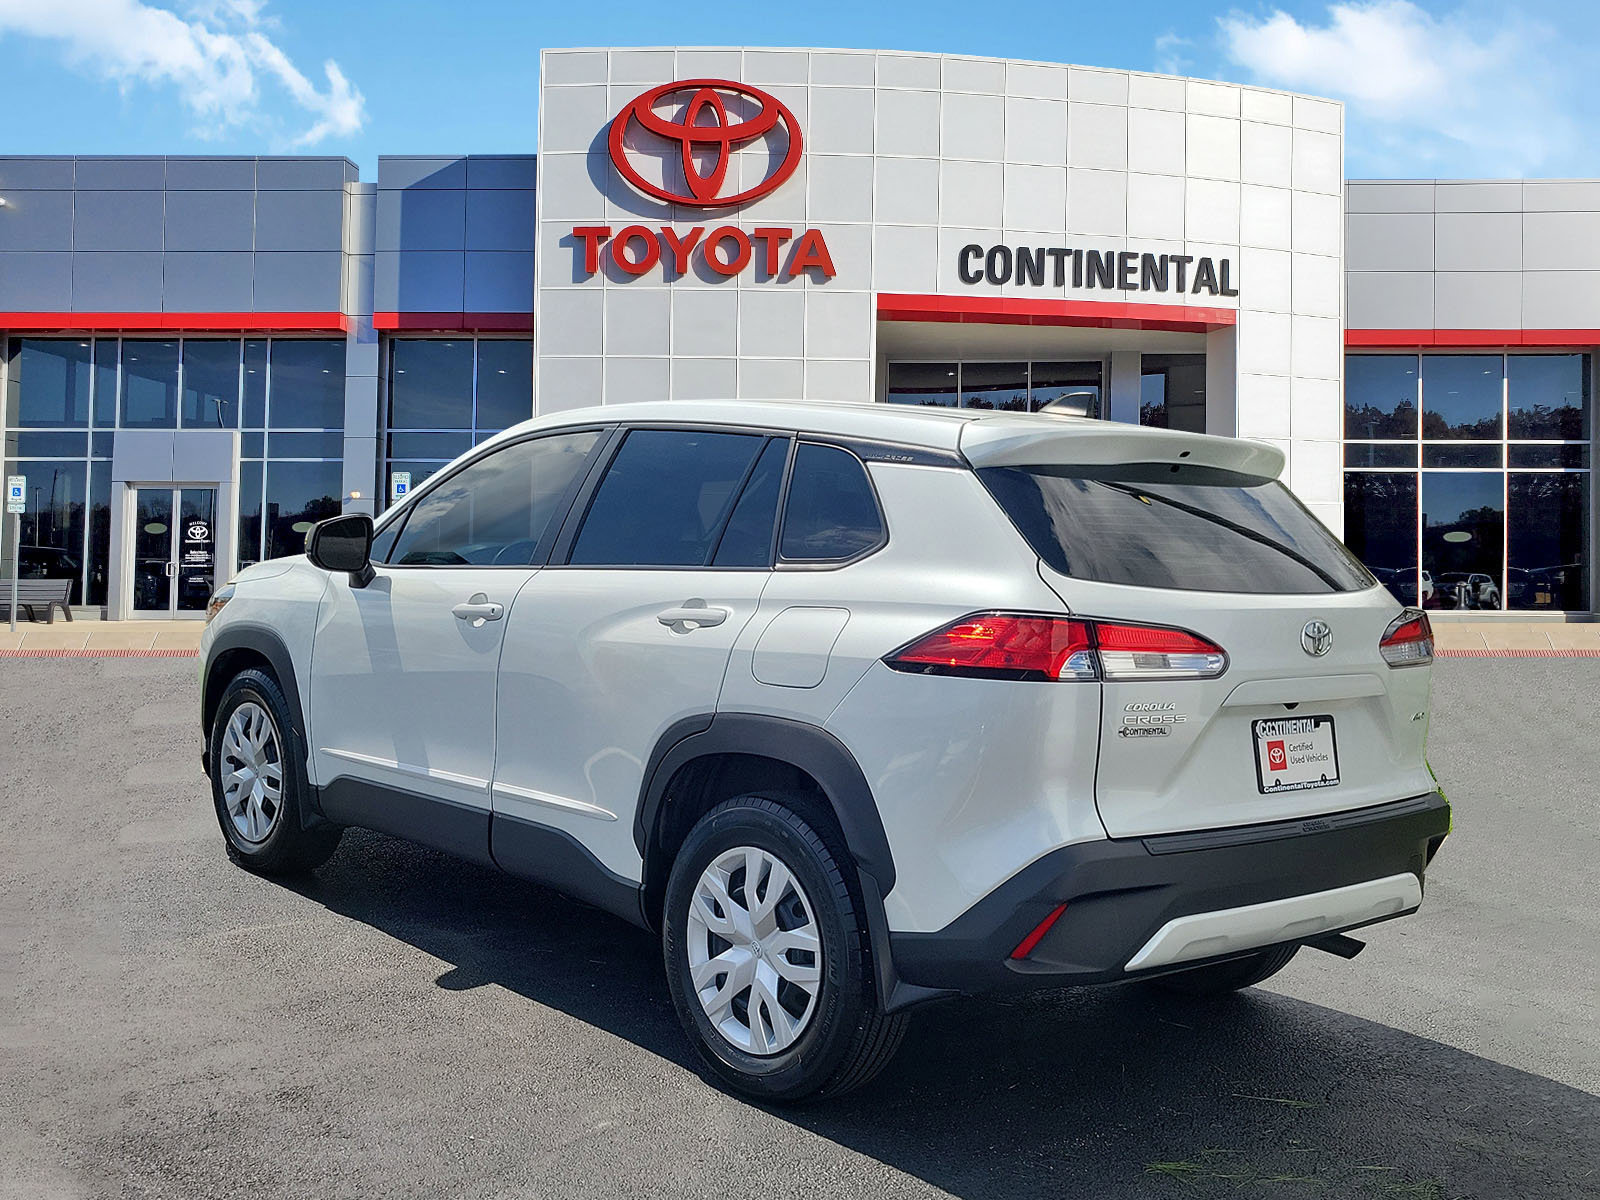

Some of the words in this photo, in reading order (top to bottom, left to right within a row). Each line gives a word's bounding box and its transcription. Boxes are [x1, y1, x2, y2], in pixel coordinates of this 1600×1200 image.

[572, 225, 836, 278] TOYOTA
[958, 244, 1239, 297] CONTINENTAL
[1124, 703, 1176, 712] COROLLA
[1123, 714, 1187, 725] CROSS
[1123, 727, 1167, 737] CONTINENTAL
[1256, 719, 1317, 739] CONTINENTAL
[1288, 742, 1314, 752] Certified
[1290, 757, 1305, 765] Used
[1306, 753, 1329, 763] Vehicles
[1263, 780, 1340, 793] ContinentalToyota.com
